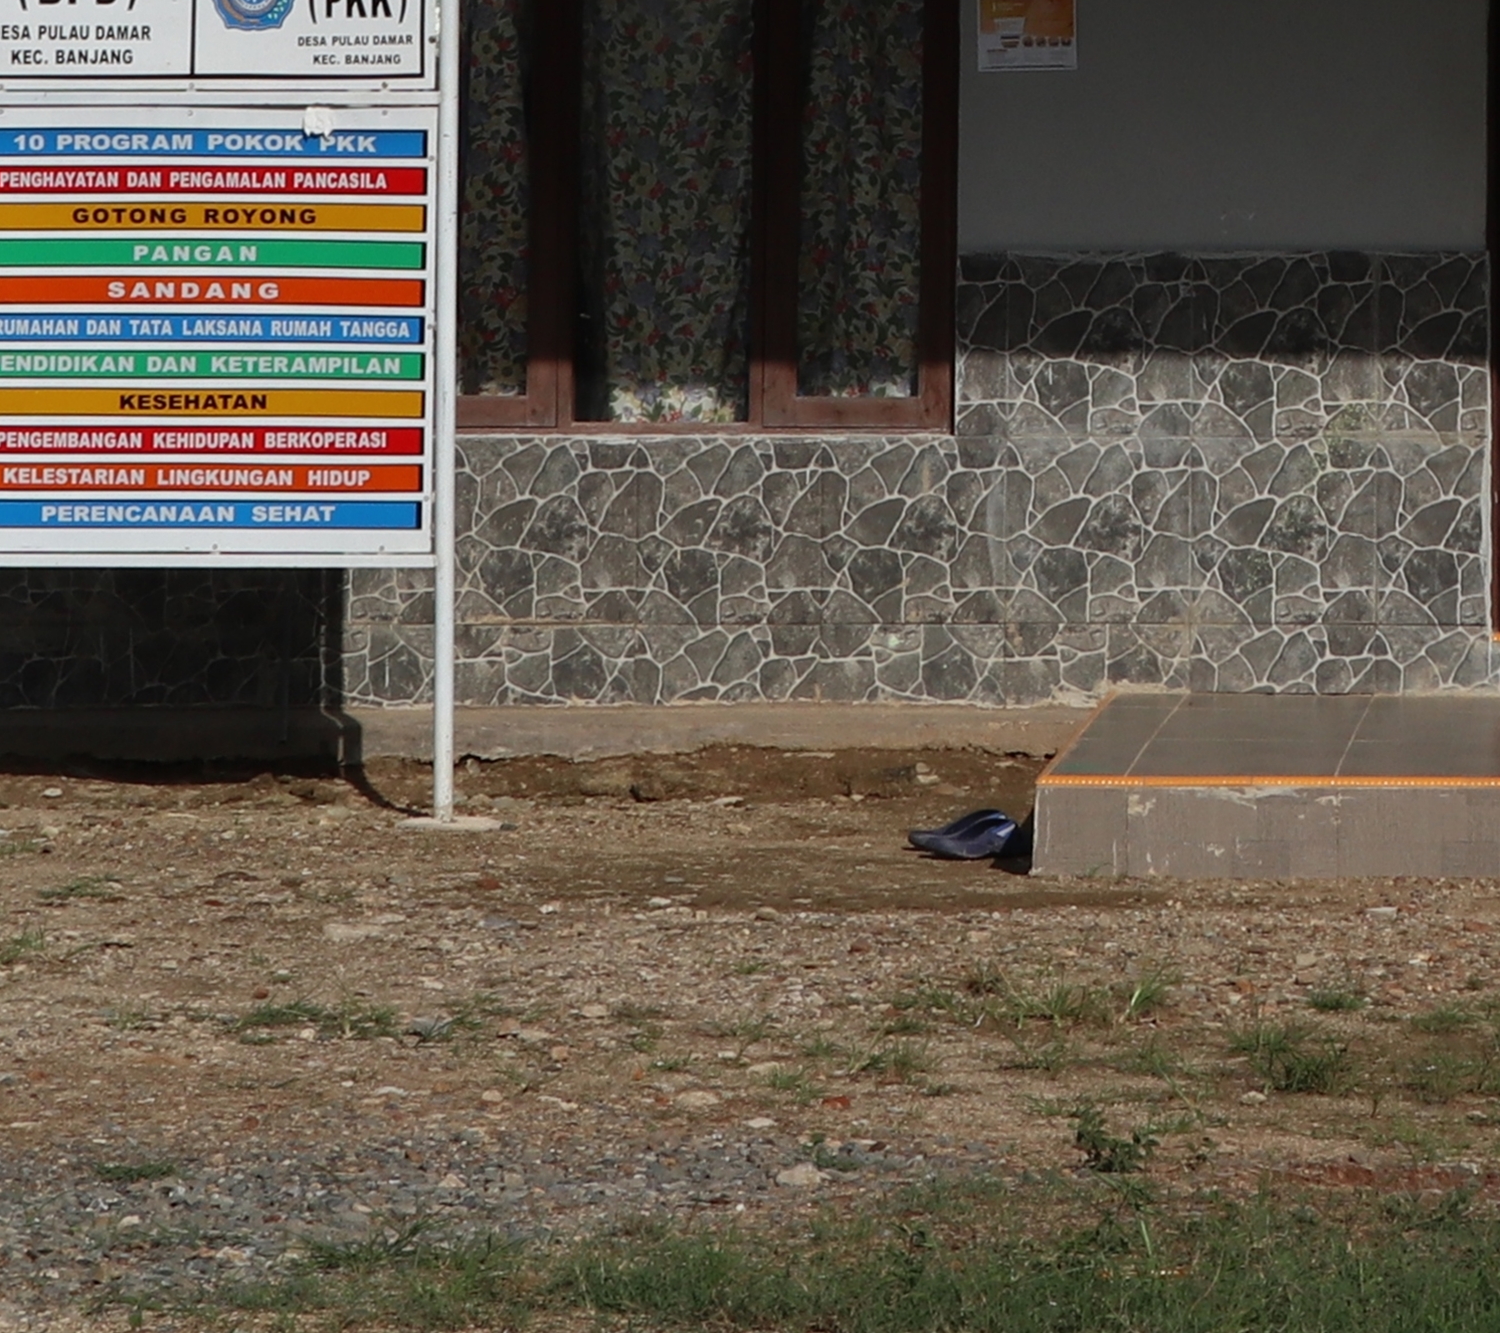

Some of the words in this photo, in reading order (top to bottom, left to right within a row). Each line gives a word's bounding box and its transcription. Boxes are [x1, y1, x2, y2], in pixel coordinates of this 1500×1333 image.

[38, 24, 90, 41] PULAU
[95, 25, 151, 41] DAMAR
[297, 35, 327, 47] DESA
[331, 35, 370, 47] PULAU
[372, 34, 414, 46] DAMAR
[11, 49, 48, 65] KEC.
[55, 49, 133, 65] BANJANG
[312, 54, 342, 65] KEC.
[344, 53, 402, 65] BANJANG
[13, 134, 46, 151] 10
[56, 133, 194, 151] PROGRAM
[207, 133, 304, 152] POKOK
[319, 135, 378, 153] PKK
[126, 171, 162, 189] DAN
[169, 171, 286, 190] PENGAMALAN
[293, 171, 387, 190] PANCASILA
[72, 208, 187, 225] GOTONG
[203, 208, 317, 226] ROYONG
[133, 245, 257, 262] PANGAN
[107, 281, 279, 300] SANDANG
[86, 319, 122, 337] DAN
[128, 319, 172, 337] TATA
[182, 319, 264, 338] LAKSANA
[270, 320, 332, 338] RUMAH
[339, 320, 410, 339] TANGGA
[146, 356, 197, 374] DAN
[210, 356, 401, 375] KETERAMPILAN
[119, 394, 267, 411] KESEHATAN
[152, 431, 255, 450] KEHIDUPAN
[264, 431, 387, 450] BERKOPERASI
[2, 467, 145, 487] KELESTARIAN
[157, 468, 293, 487] LINGKUNGAN
[307, 468, 371, 487] HIDUP
[41, 504, 235, 523] PERENCANAAN
[251, 504, 336, 523] SEHAT
